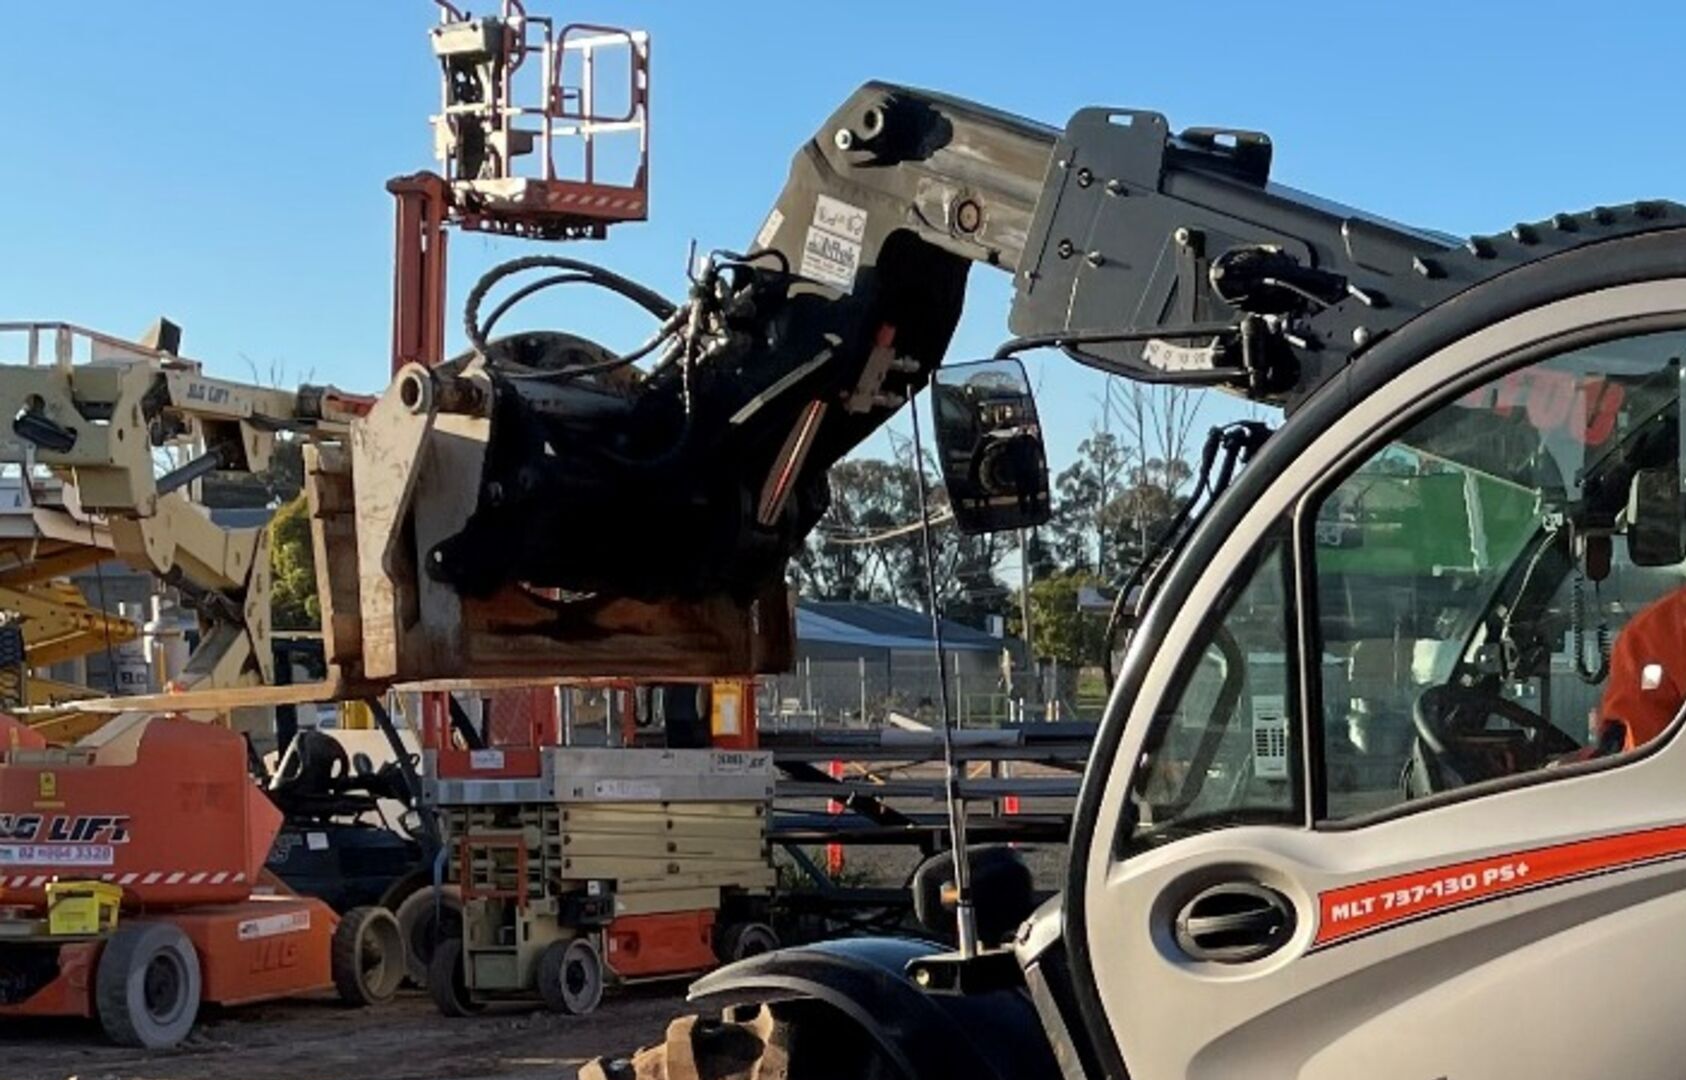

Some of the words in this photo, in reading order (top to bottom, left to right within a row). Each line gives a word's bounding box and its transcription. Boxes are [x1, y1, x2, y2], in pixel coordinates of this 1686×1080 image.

[48, 815, 130, 842] LIFT
[1331, 896, 1377, 923] MLT
[1380, 873, 1478, 910] 737-130
[1482, 861, 1530, 887] PS+
